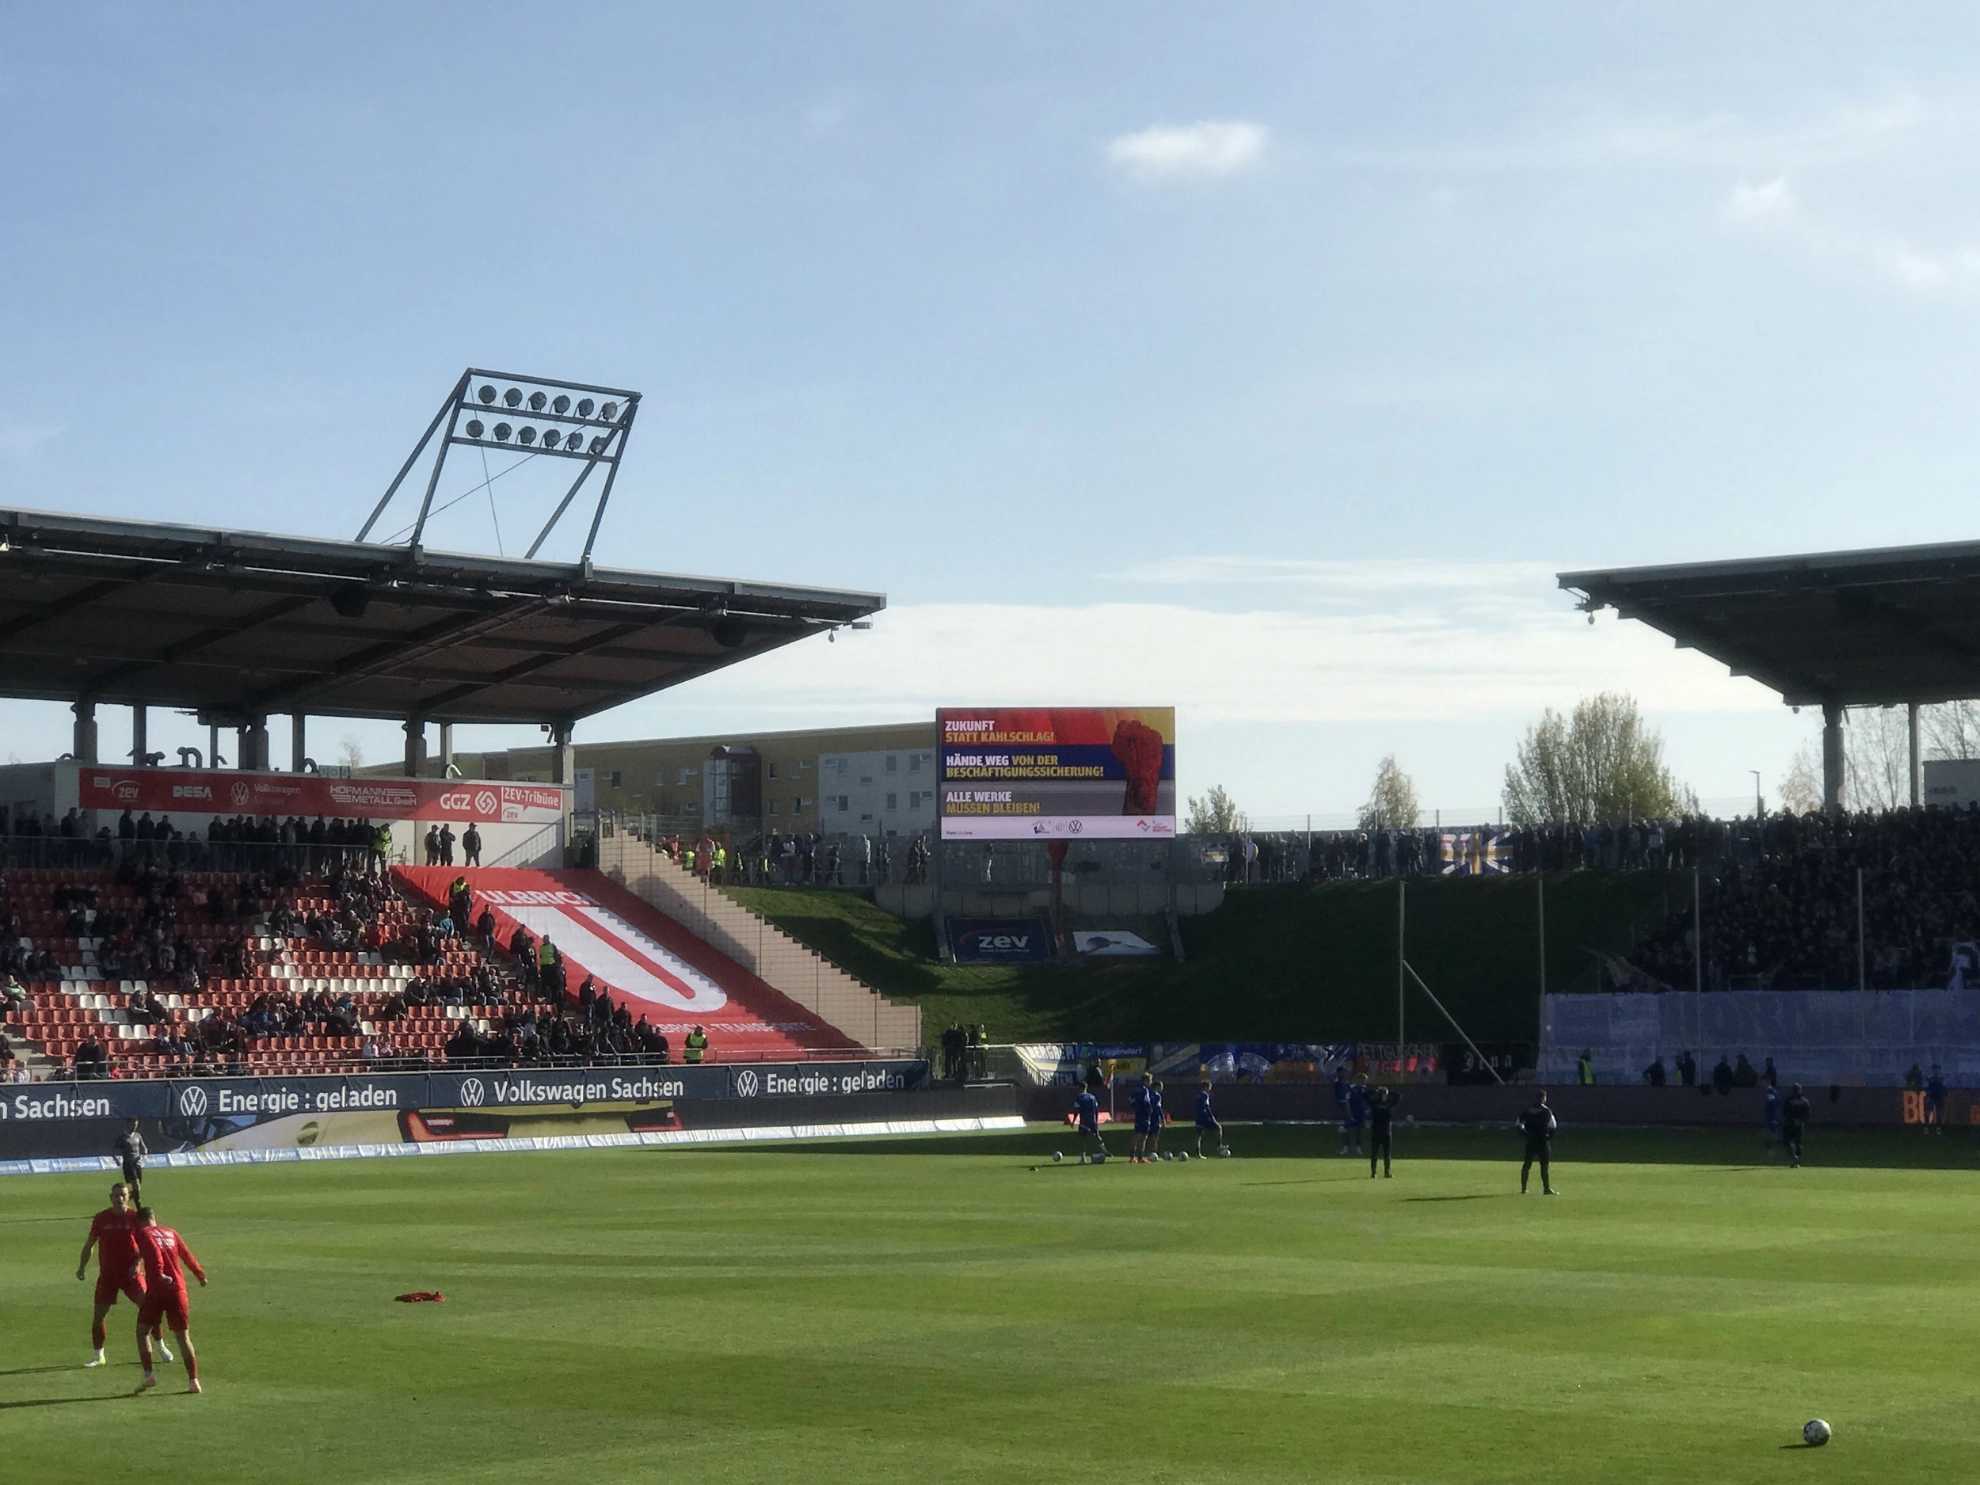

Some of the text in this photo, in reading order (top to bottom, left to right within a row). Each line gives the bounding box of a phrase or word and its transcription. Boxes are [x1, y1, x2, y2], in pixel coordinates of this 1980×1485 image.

[945, 721, 995, 731] ZUKUNFT
[945, 732, 1055, 742] STATT KAHLSCHLAG!
[946, 753, 1059, 766] HÄNDE WEG VON DER
[946, 765, 1104, 778] BESCHÄFTIGUNGSSICHERUNG!
[173, 786, 213, 798] DESA
[254, 783, 301, 796] Volkswagen
[330, 785, 386, 795] HOFMANN
[352, 795, 393, 804] METALL
[440, 793, 471, 810] GGZ
[504, 787, 559, 806] ZEV-Tribüne
[946, 791, 1012, 802] ALLE WERKE
[993, 802, 1040, 813] BLEIBEN!
[474, 889, 600, 905] ULBRICH
[978, 936, 1029, 948] zev
[767, 1072, 828, 1095] Energie
[841, 1069, 905, 1094] geladen
[494, 1077, 684, 1102] Volkswagen Sachsen
[219, 1087, 299, 1113] Energie
[316, 1084, 397, 1111] geladen
[15, 1093, 110, 1119] Sachsen
